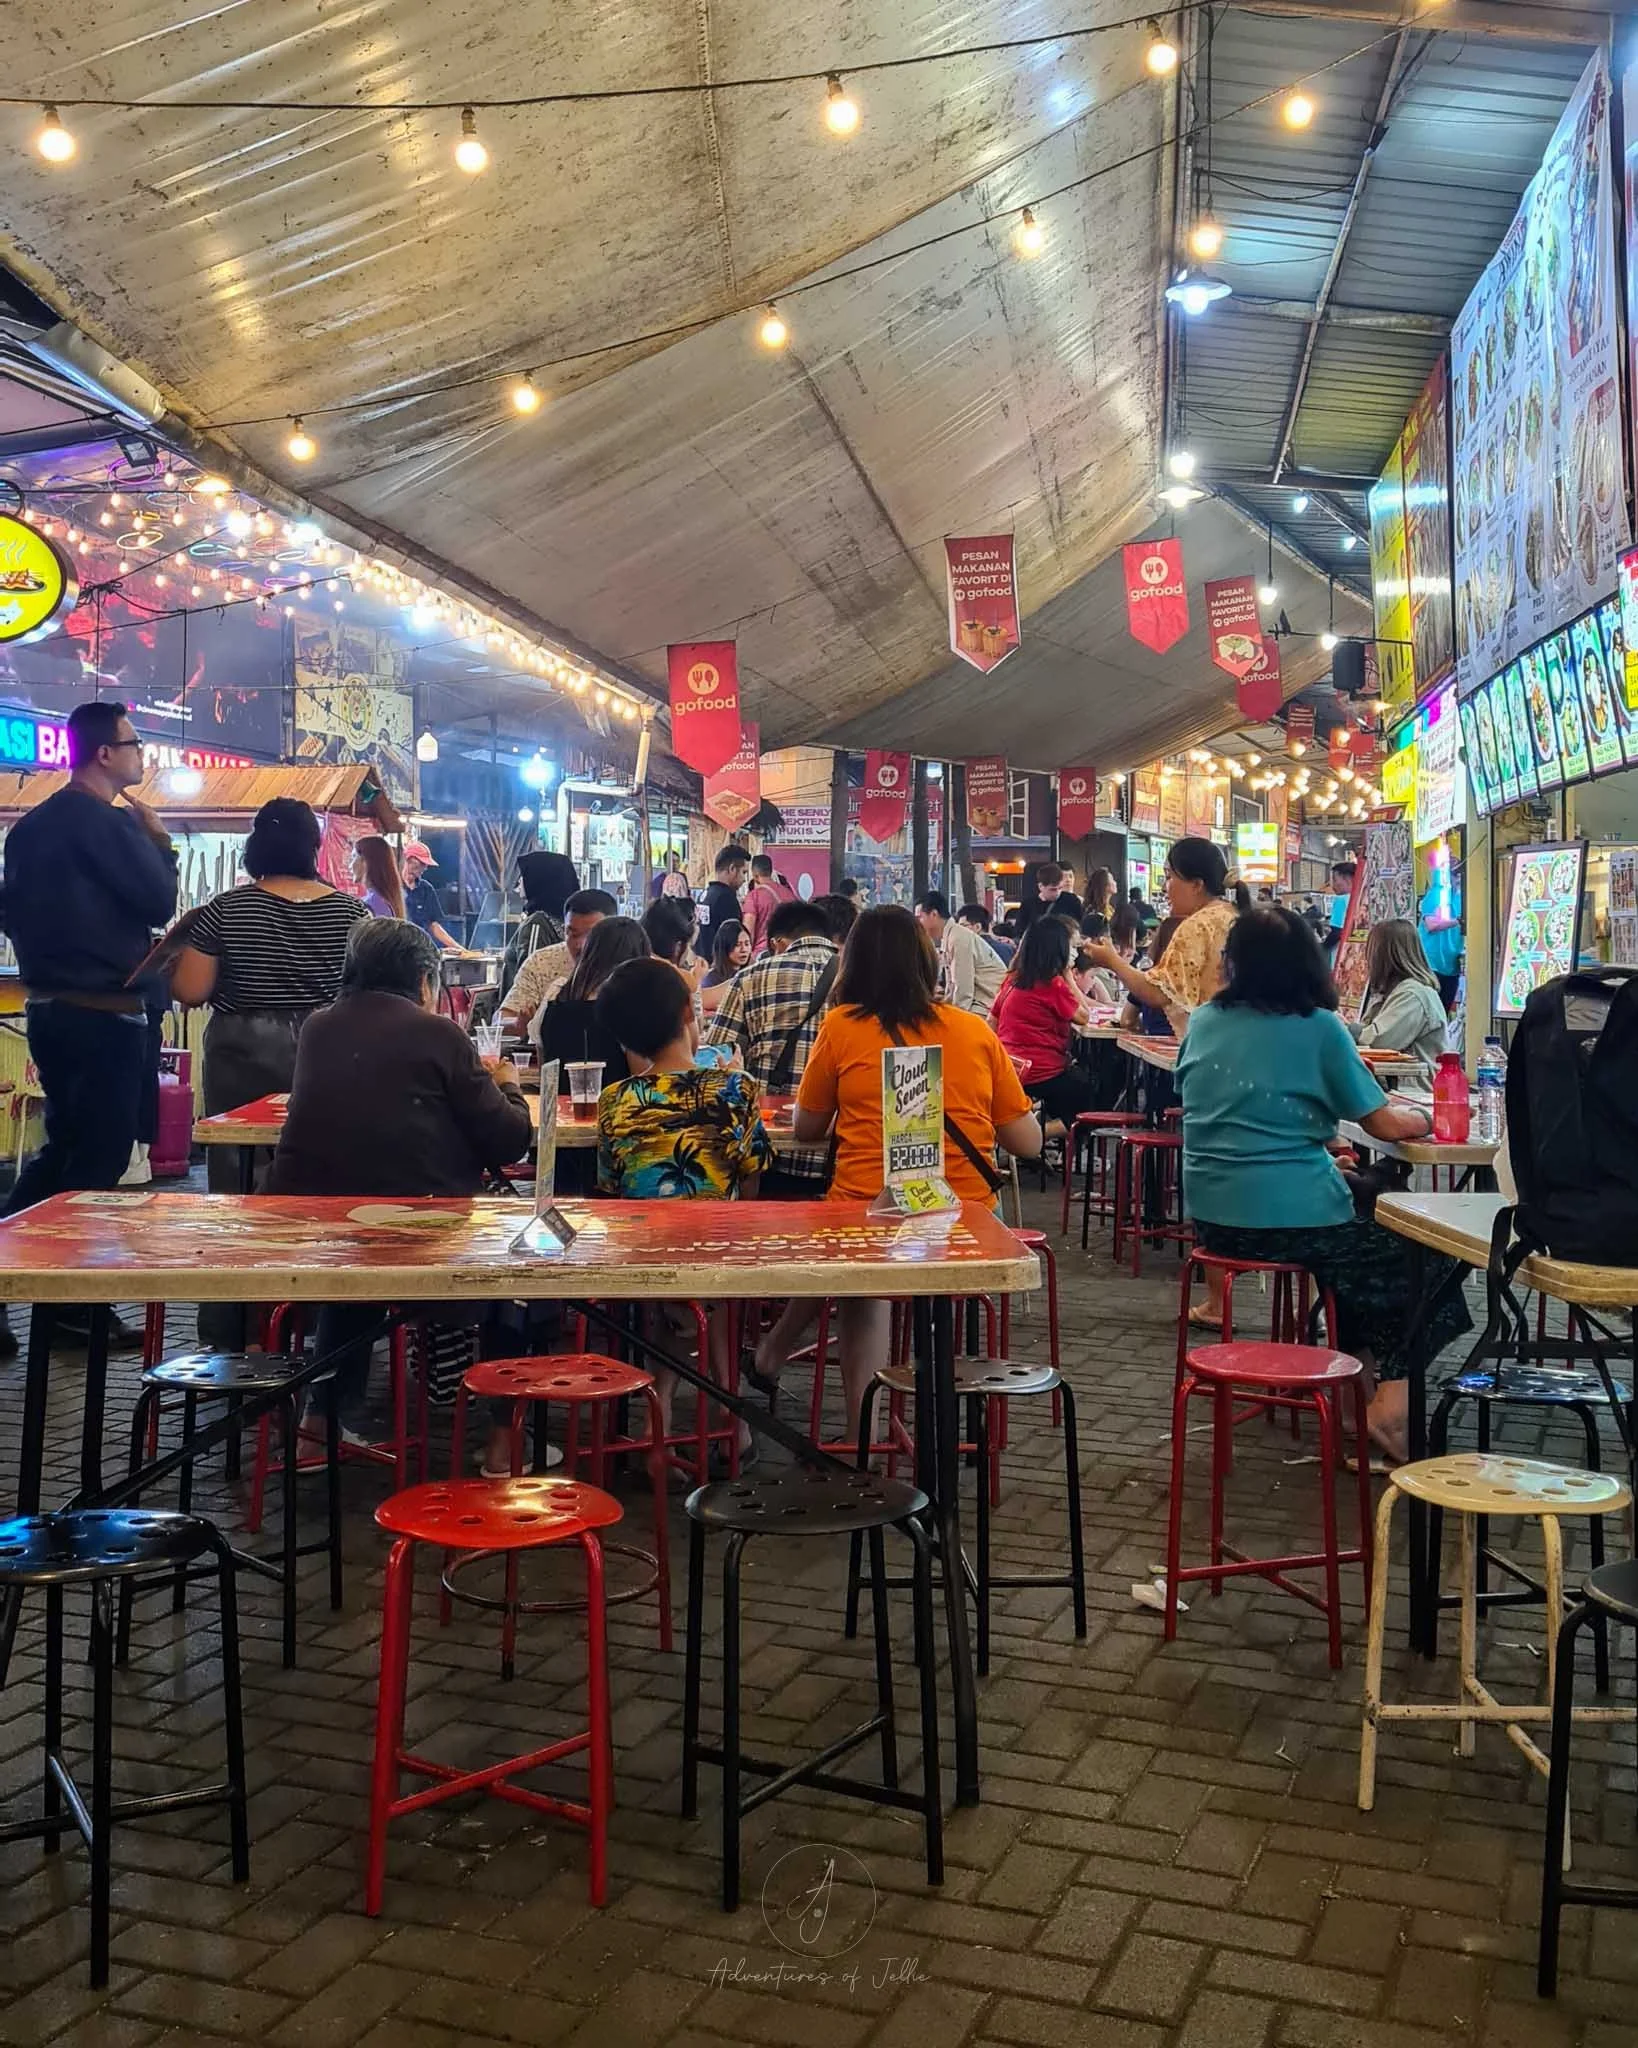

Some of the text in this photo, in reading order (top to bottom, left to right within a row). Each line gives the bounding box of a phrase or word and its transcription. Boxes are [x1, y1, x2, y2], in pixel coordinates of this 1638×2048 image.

[962, 551, 999, 561] PESAN
[952, 561, 1010, 573] MAKANAN
[952, 573, 1012, 585] FAVORIT DI
[967, 586, 1012, 600] gofood
[1130, 582, 1183, 602] gofood
[1217, 587, 1245, 598] PESAN
[1211, 595, 1253, 607] MAKANAN
[1211, 603, 1255, 617] FAVORIT DI
[1223, 612, 1256, 627] gofood
[1239, 671, 1280, 686] gofood
[674, 694, 737, 716] gofood
[865, 788, 907, 799] gofood
[978, 786, 1004, 795] gofood
[1061, 796, 1094, 807] gofood
[889, 1052, 928, 1090] Cloud
[895, 1078, 931, 1114] Seven
